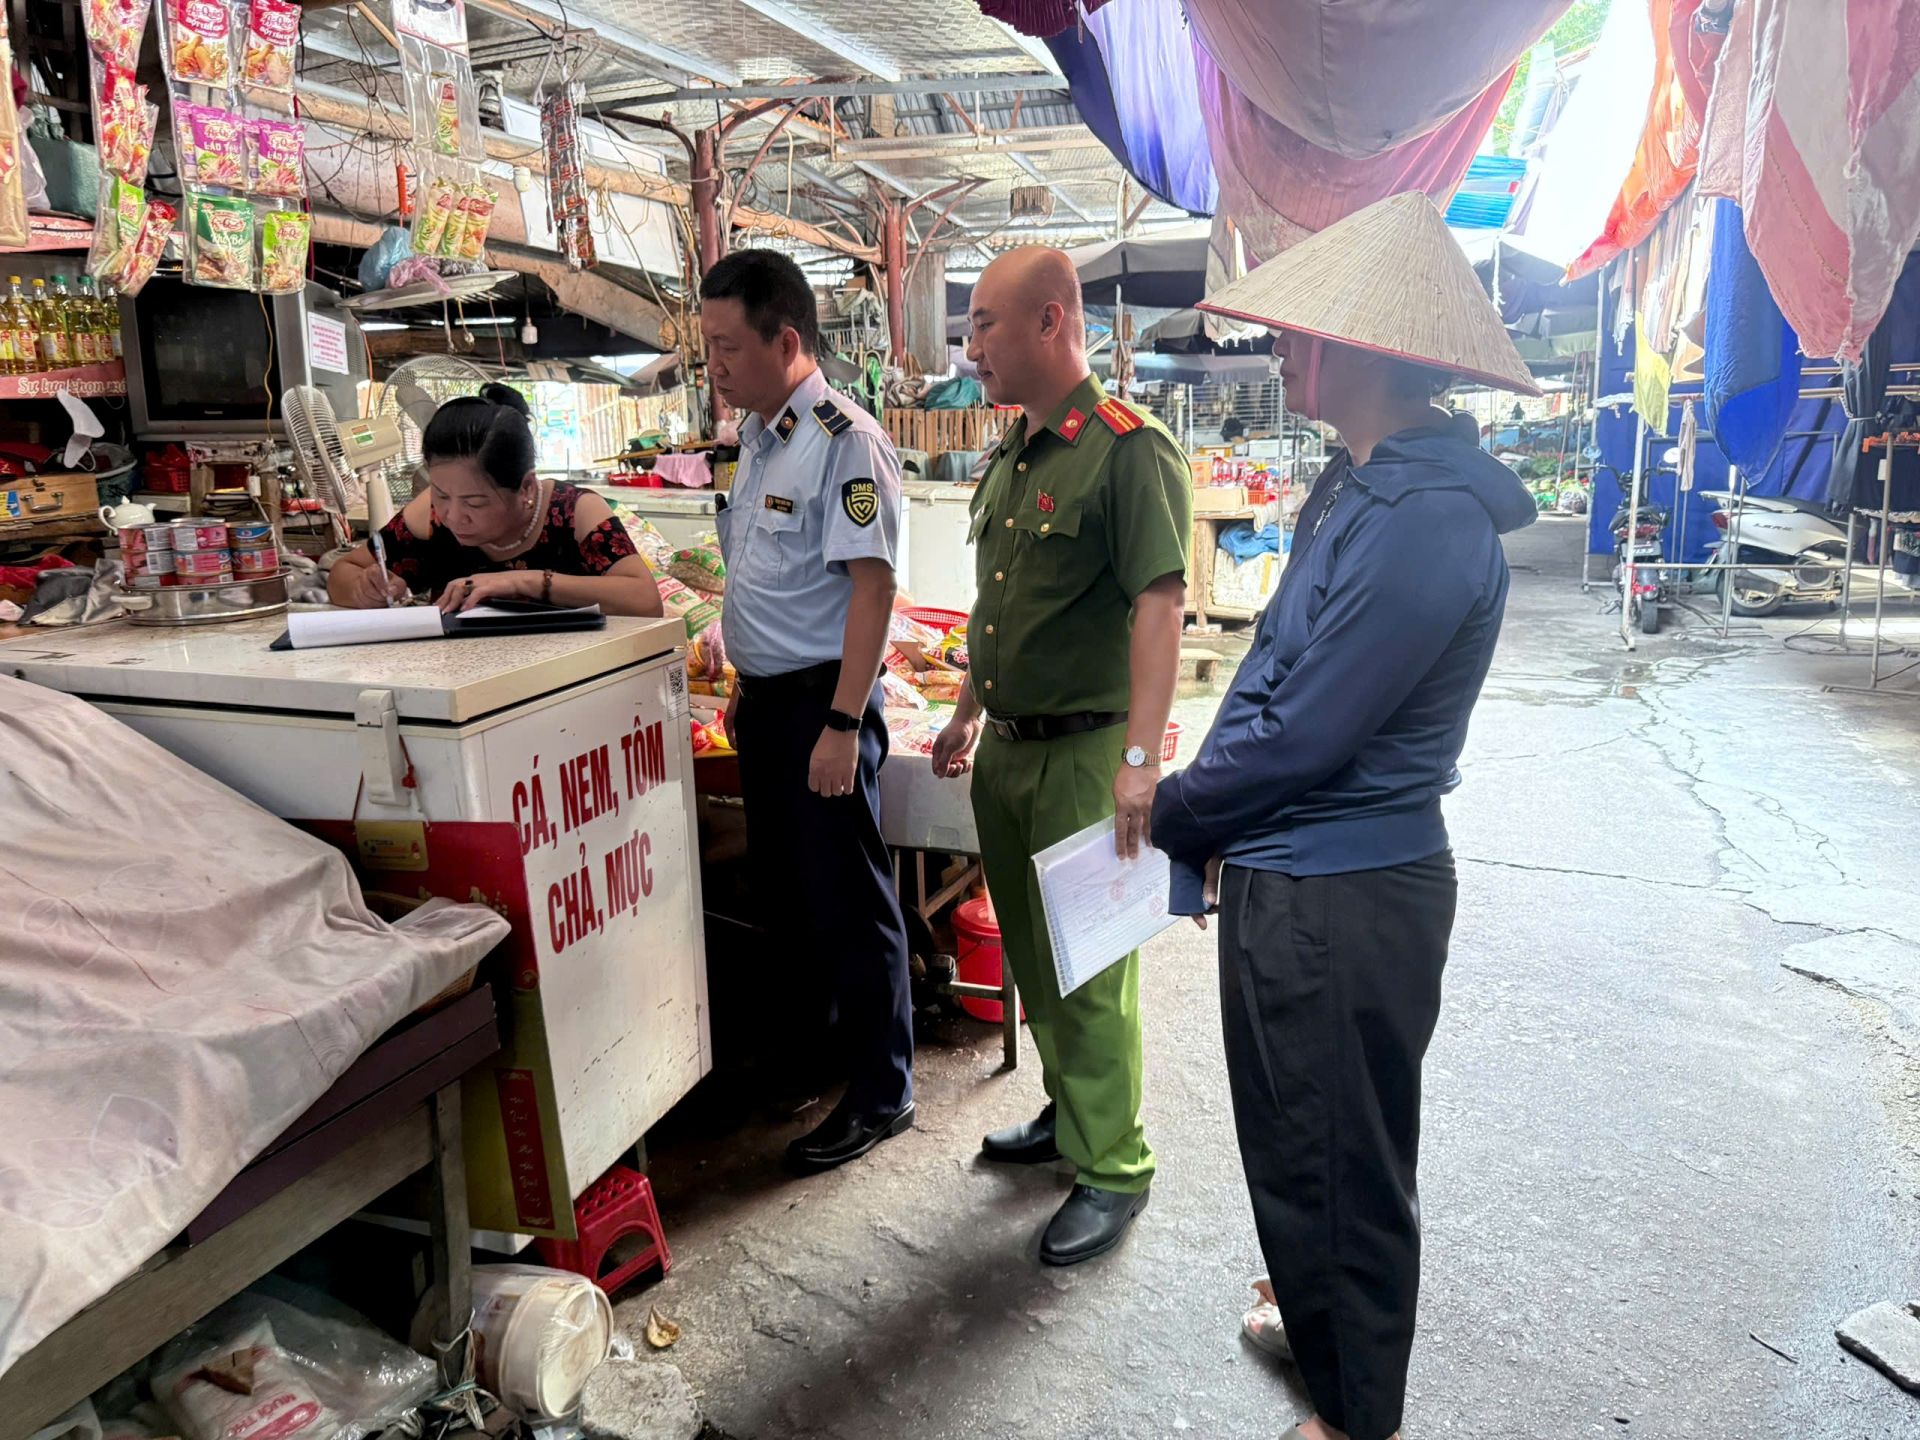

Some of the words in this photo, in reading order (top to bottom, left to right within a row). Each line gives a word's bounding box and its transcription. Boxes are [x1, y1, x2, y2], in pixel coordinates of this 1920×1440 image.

[18, 377, 40, 397] Sự
[851, 483, 874, 493] DMS
[512, 754, 557, 856] CÁ,
[559, 744, 619, 834] NEM,
[621, 715, 666, 800] TÔM
[548, 842, 604, 954] CHẢ,
[605, 829, 653, 919] MỰC
